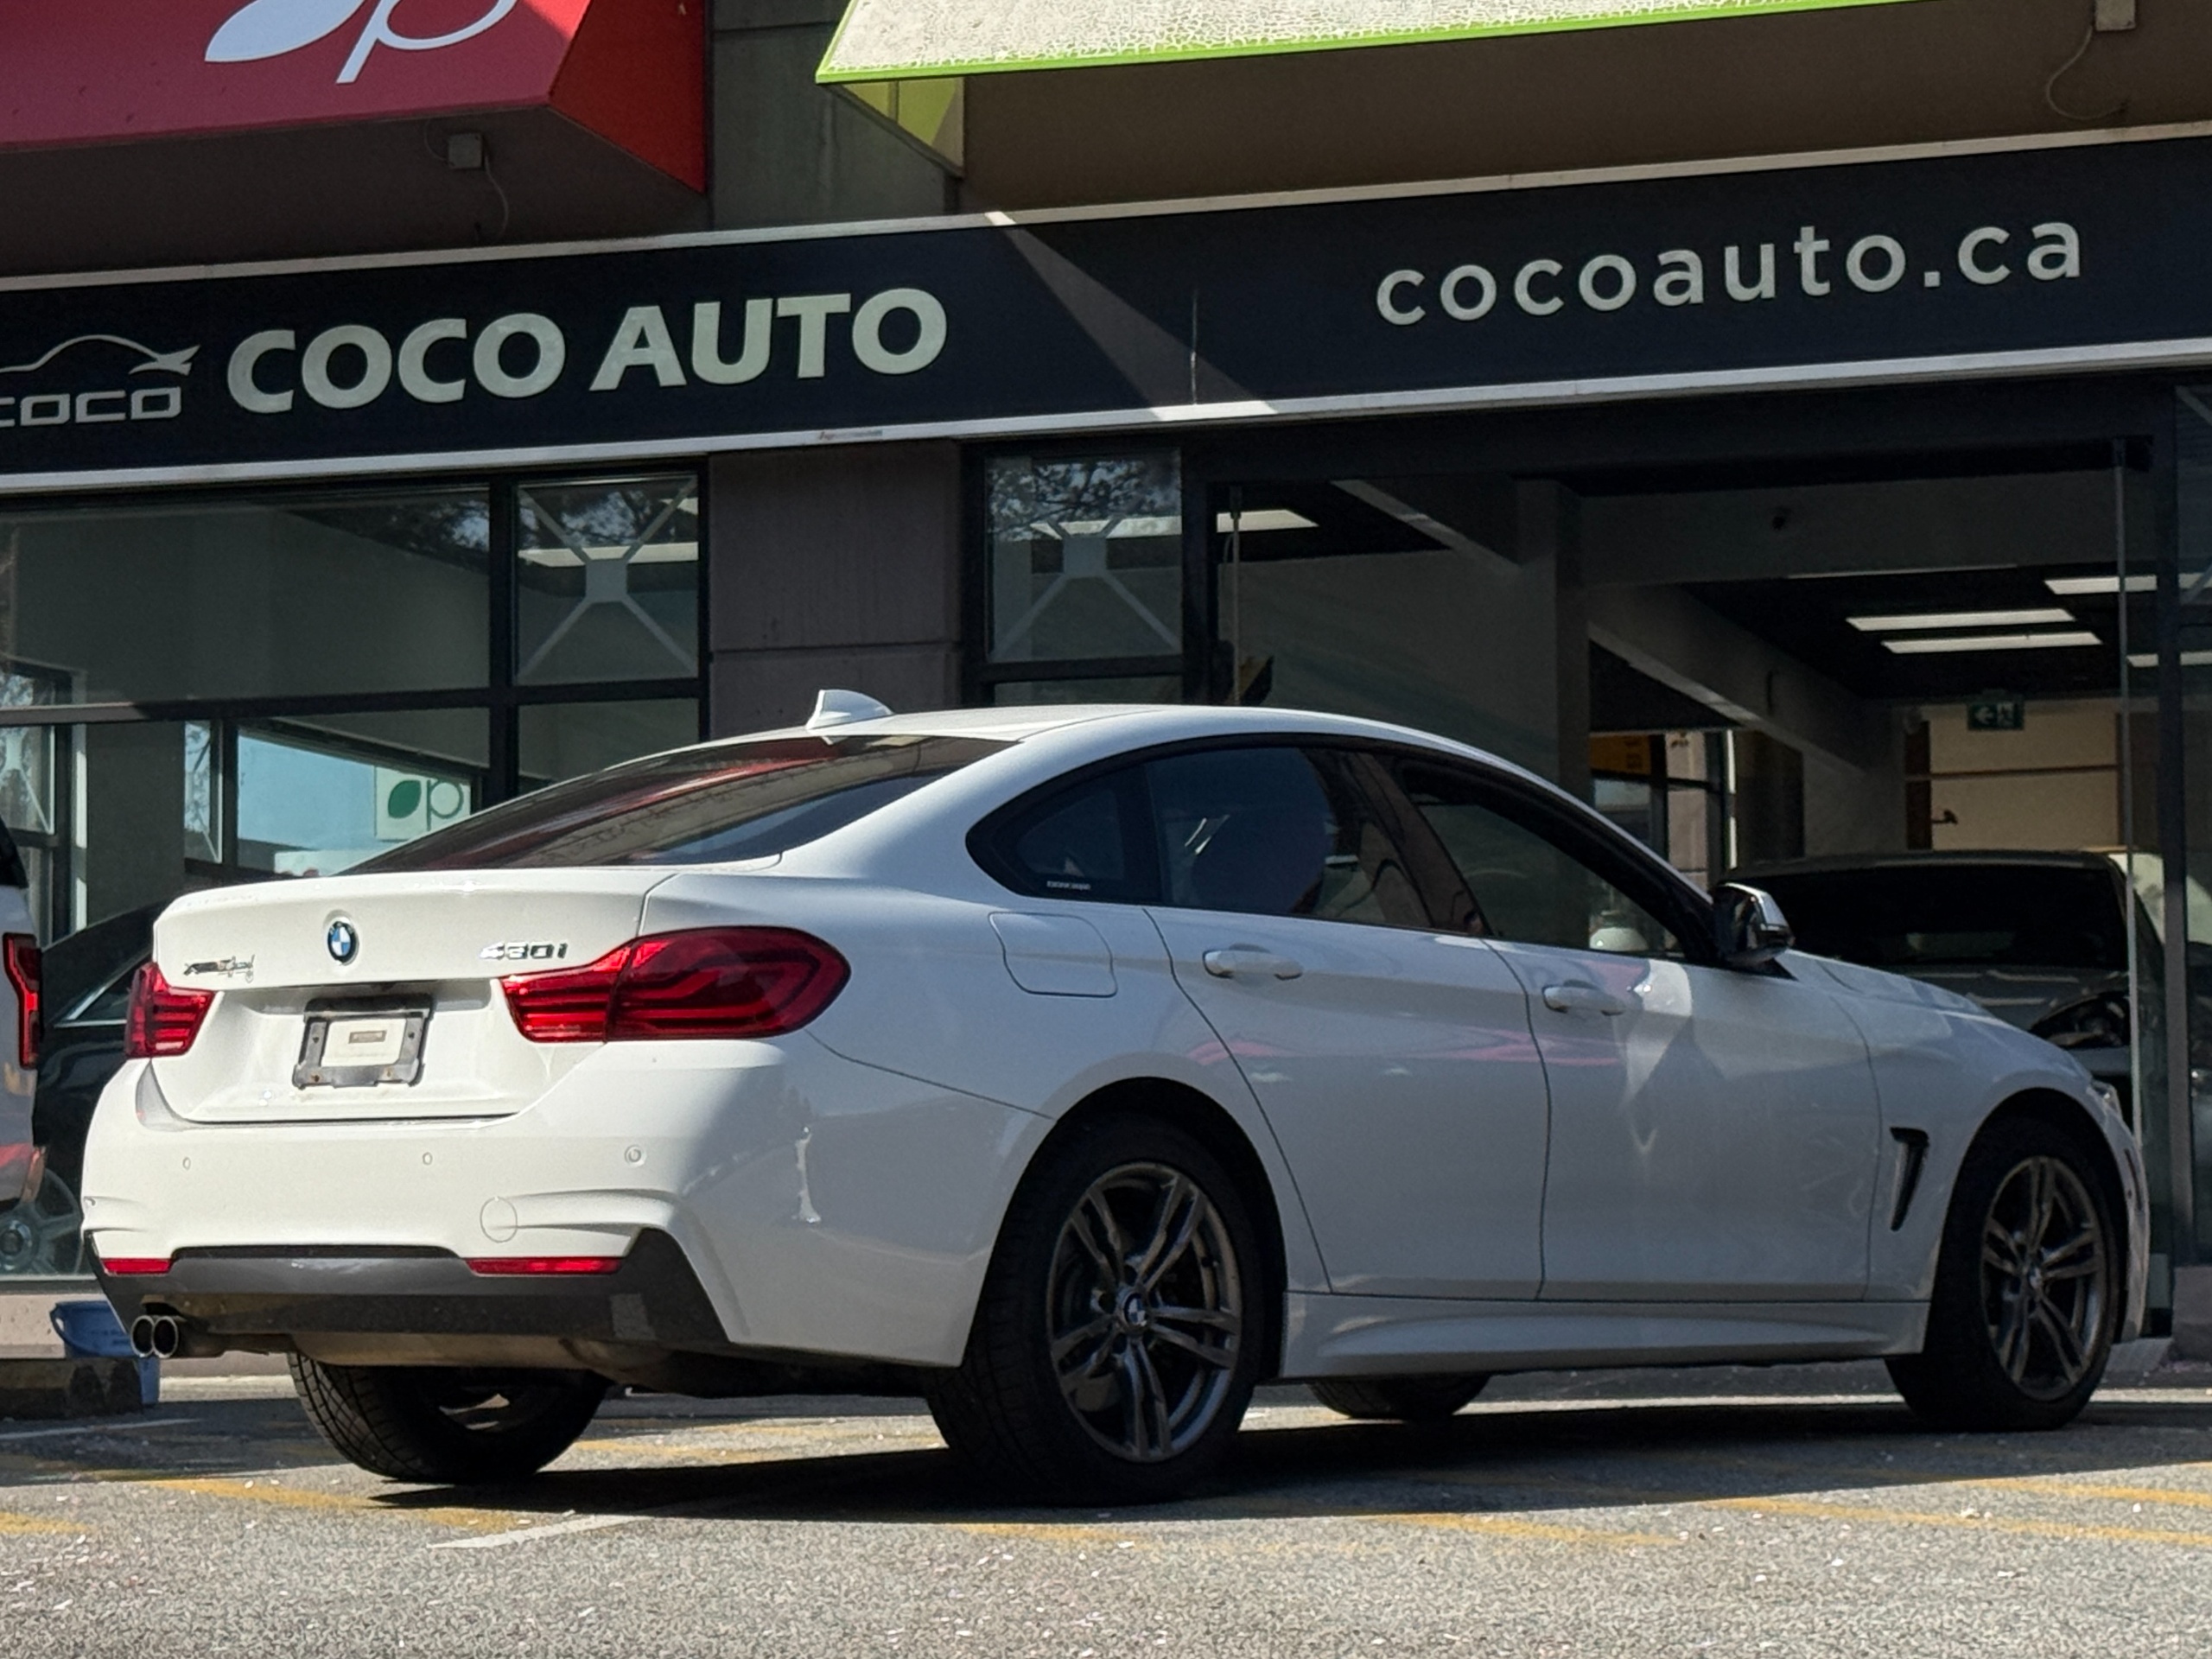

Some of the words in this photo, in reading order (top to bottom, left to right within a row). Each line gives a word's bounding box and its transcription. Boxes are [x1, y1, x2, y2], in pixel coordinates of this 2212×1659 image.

[1376, 221, 2082, 326] cocoauto.ca
[226, 311, 567, 414] COCO
[588, 286, 948, 391] AUTO
[480, 941, 569, 960] 430i
